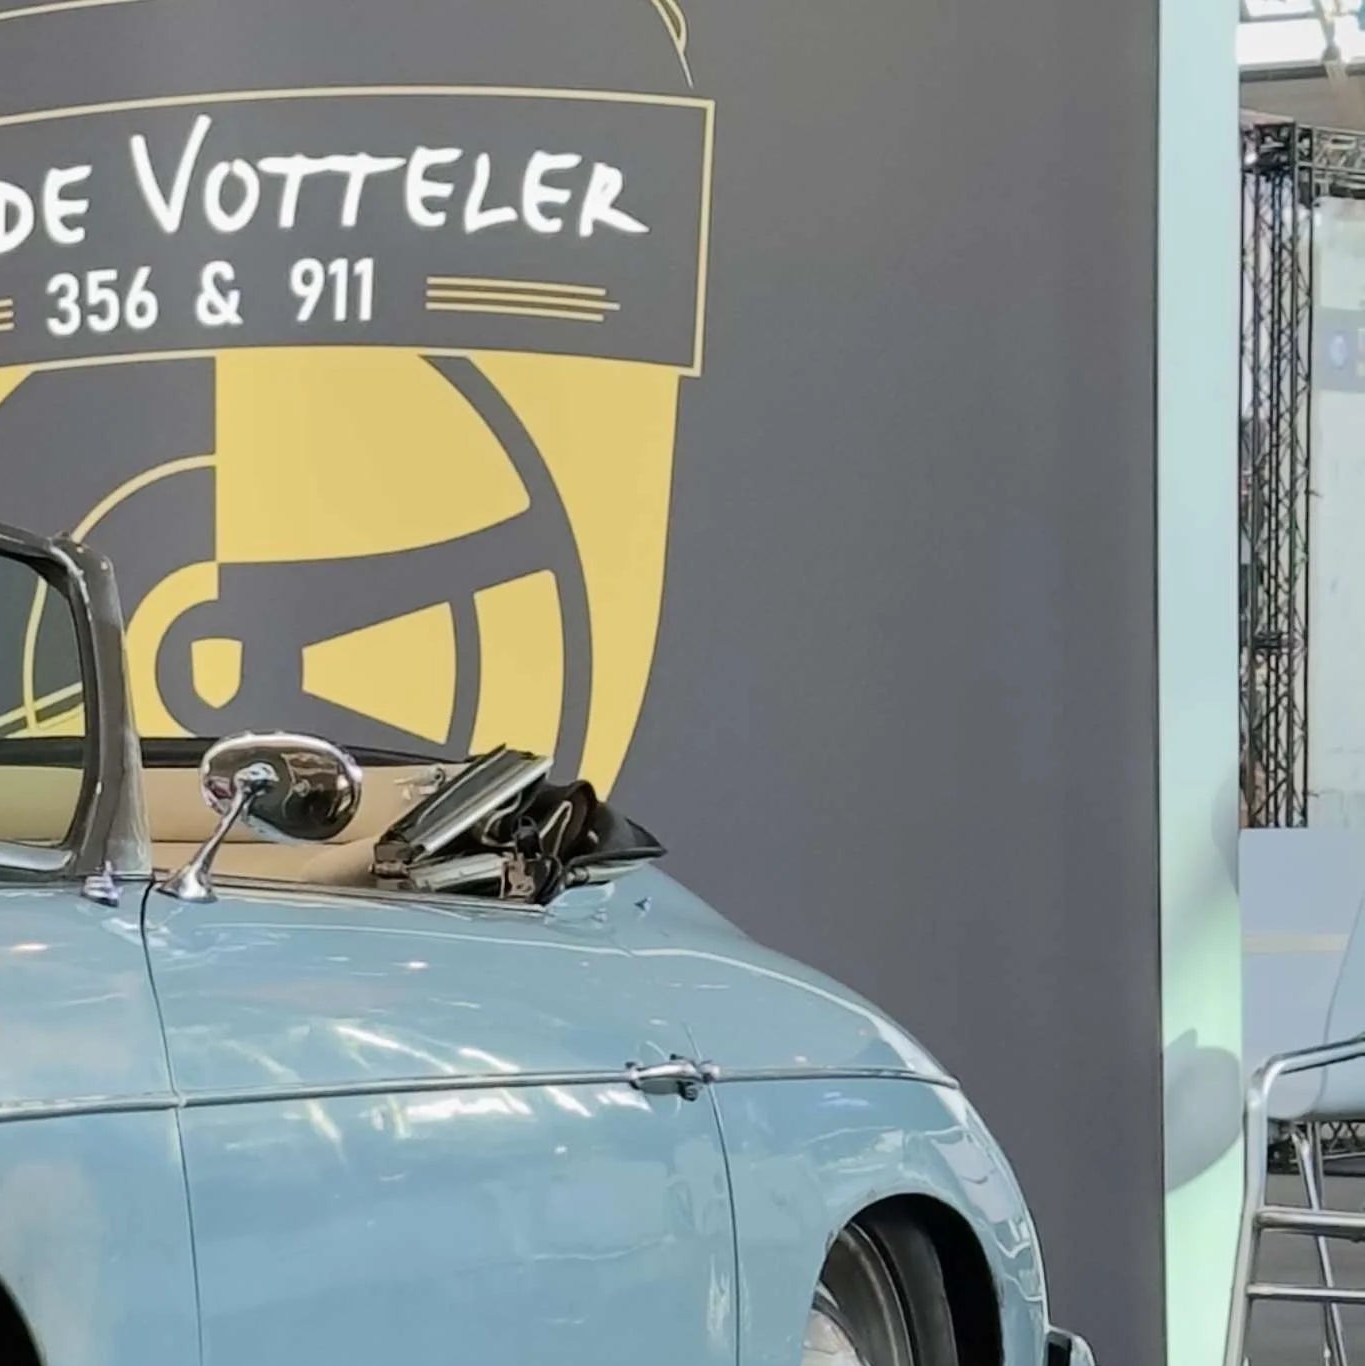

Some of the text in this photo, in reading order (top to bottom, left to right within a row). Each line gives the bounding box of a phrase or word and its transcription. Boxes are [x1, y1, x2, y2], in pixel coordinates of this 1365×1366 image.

[129, 114, 651, 238] VOTTELER
[45, 257, 375, 336] 356 & 911
